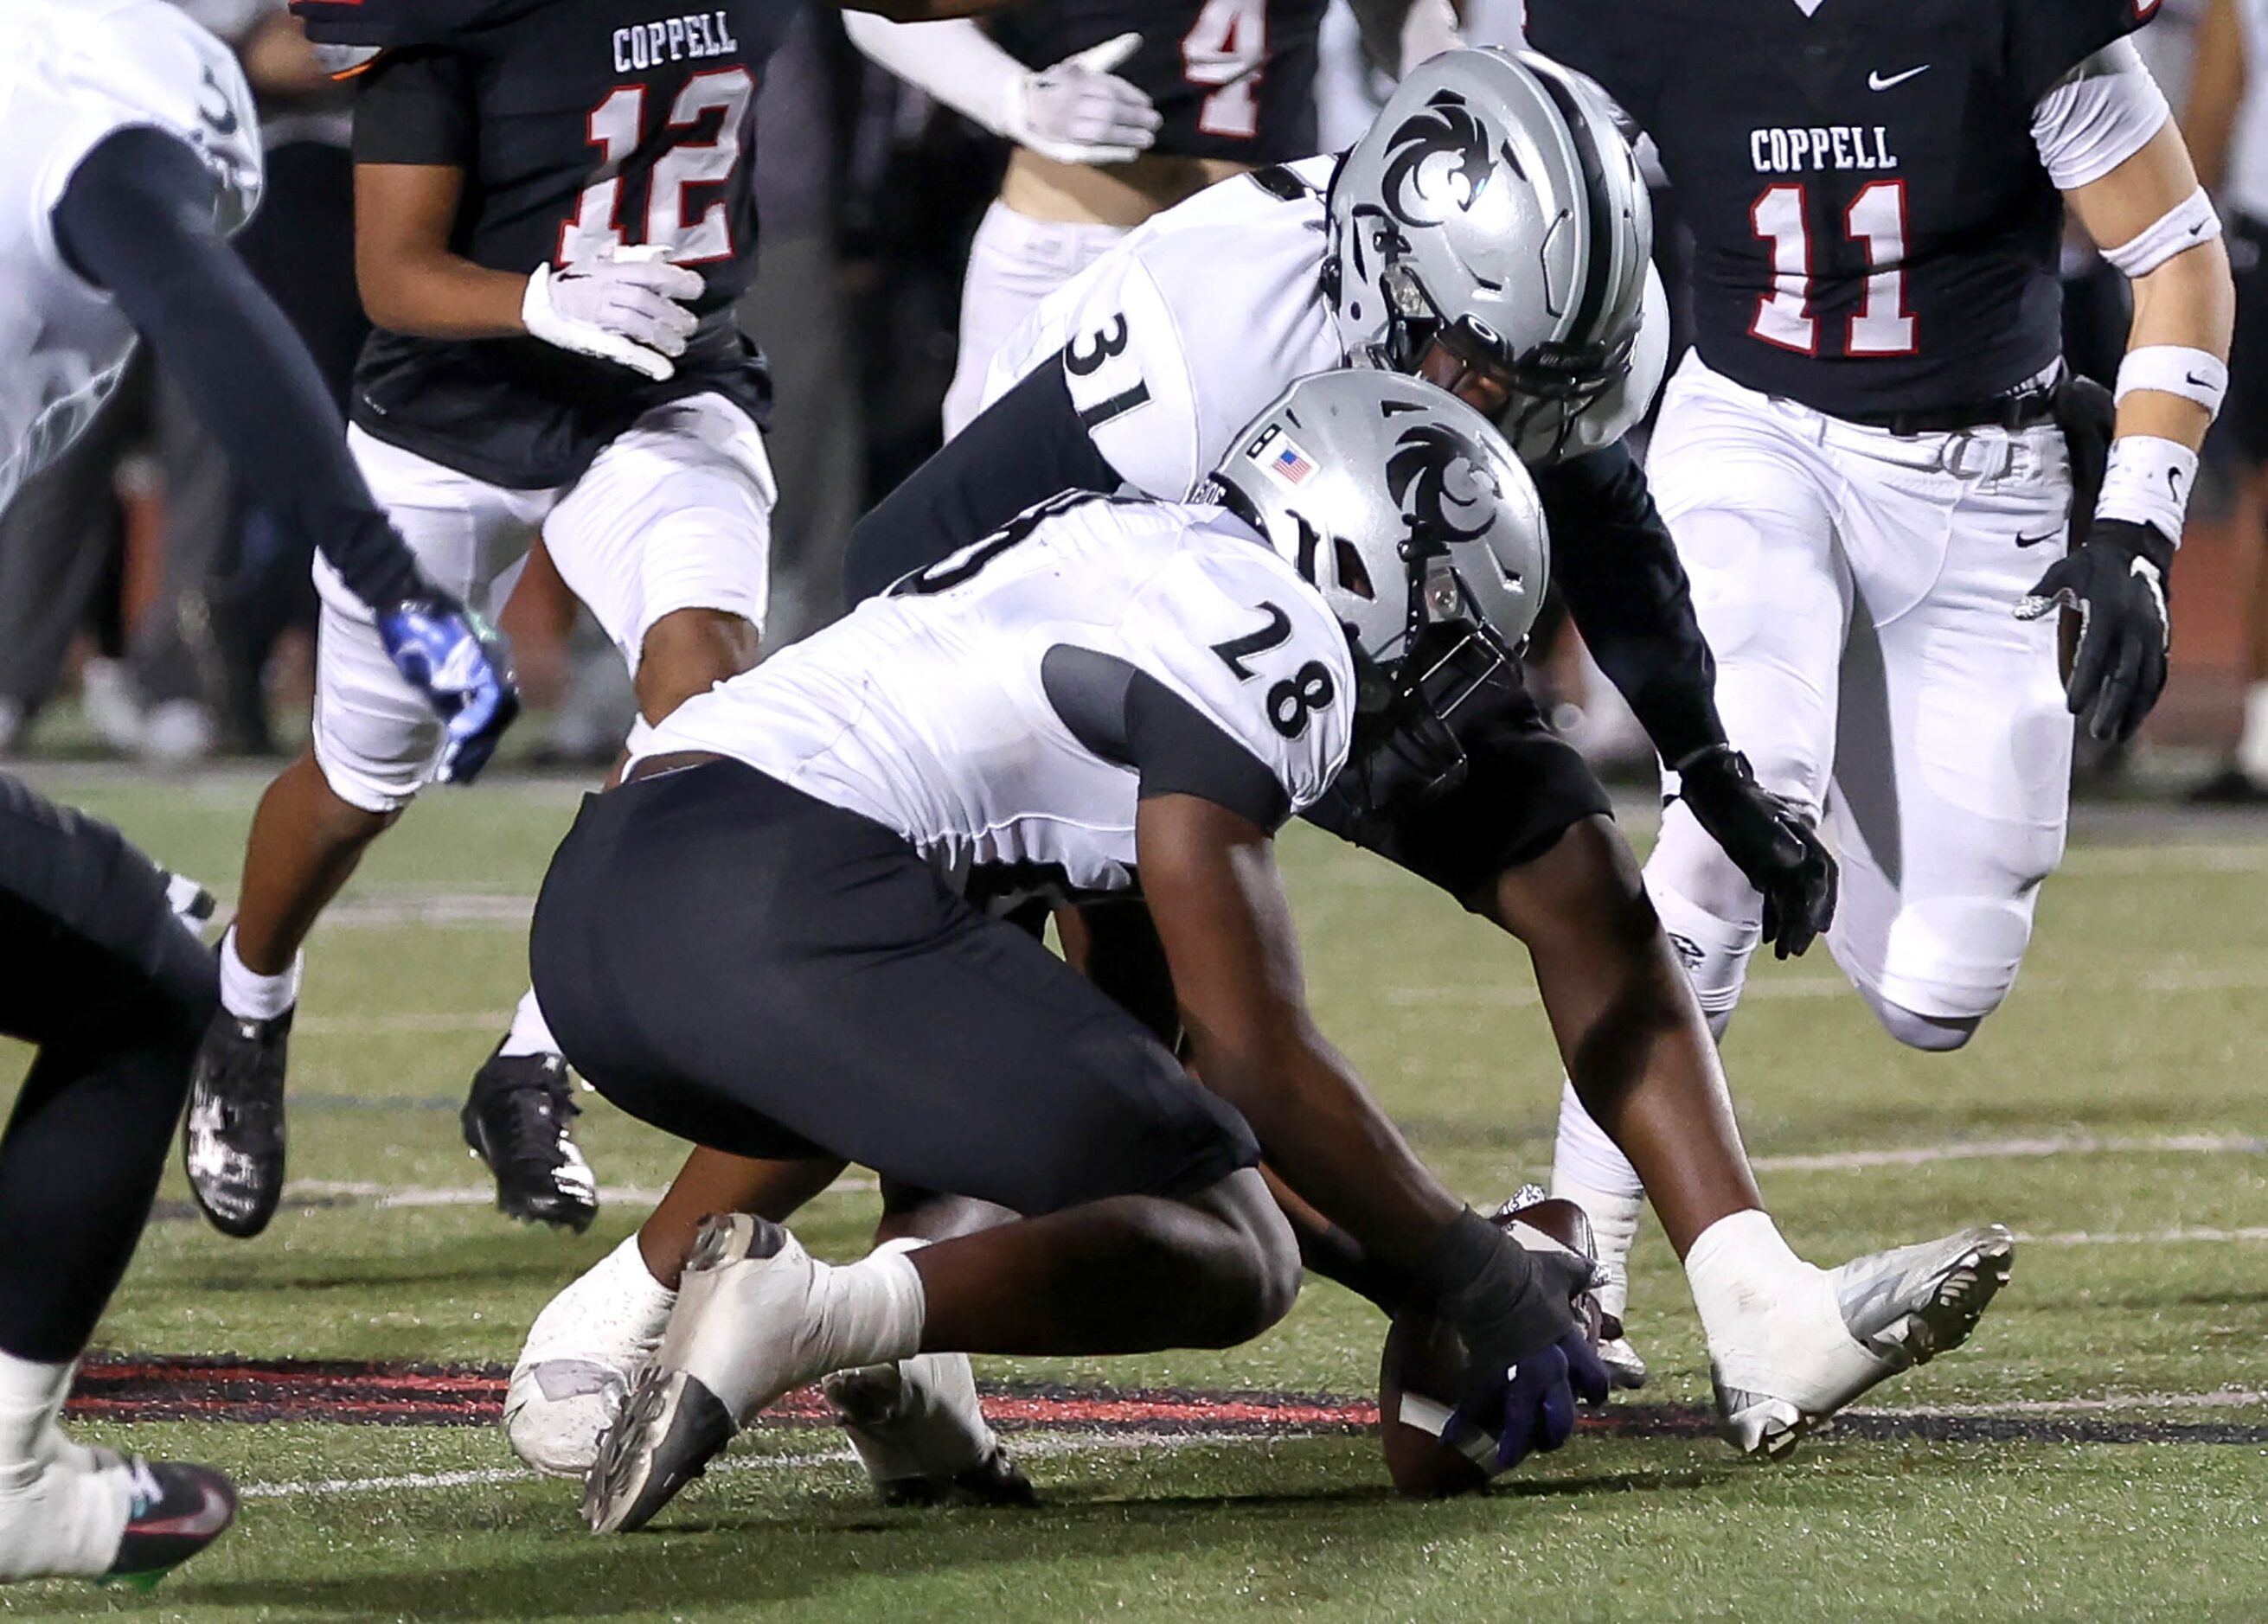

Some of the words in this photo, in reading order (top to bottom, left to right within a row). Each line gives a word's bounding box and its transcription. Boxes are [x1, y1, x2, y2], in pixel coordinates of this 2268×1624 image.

[612, 10, 739, 74] COPPELL
[556, 64, 757, 268] 12
[1749, 126, 1898, 173] COPPELL
[1746, 178, 1919, 357] 11
[1065, 311, 1152, 431] 31
[1208, 599, 1336, 741] 28
